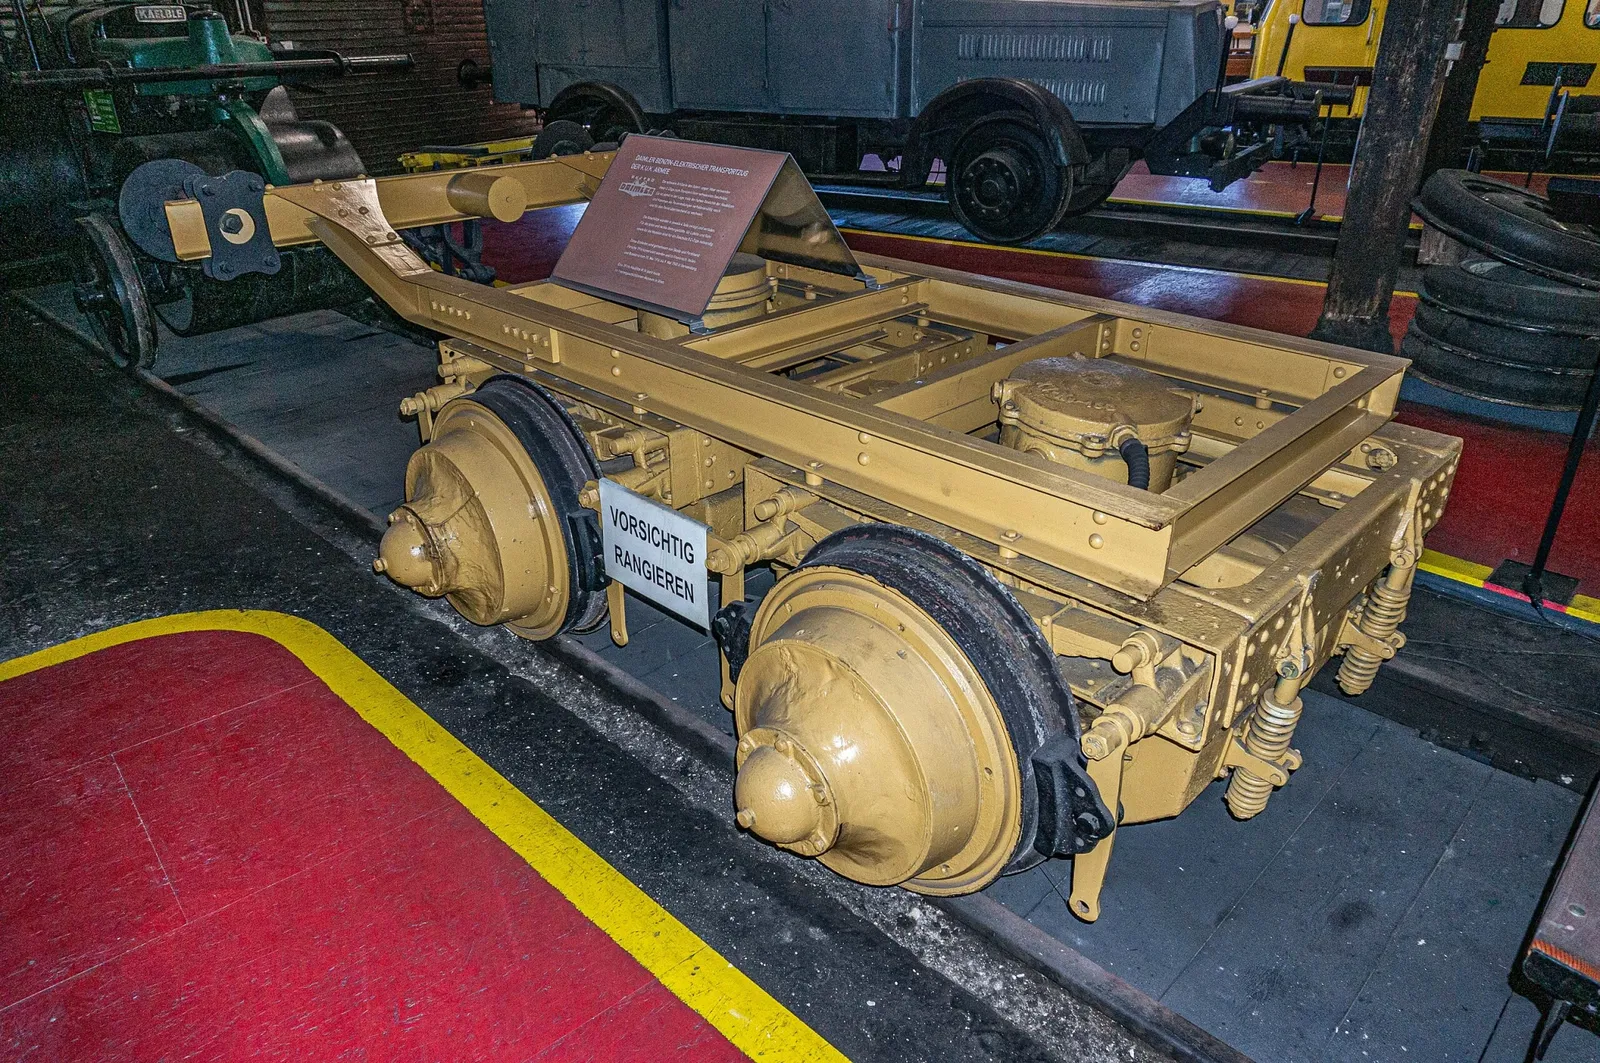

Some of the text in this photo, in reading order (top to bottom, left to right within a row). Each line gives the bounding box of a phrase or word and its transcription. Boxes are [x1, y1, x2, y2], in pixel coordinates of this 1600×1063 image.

[139, 9, 183, 19] KAELBLE
[635, 154, 656, 164] DAIMLER
[709, 164, 749, 177] TRANSPORTZUG
[653, 166, 671, 175] ARMEE
[609, 505, 695, 564] VORSICHTIG
[614, 544, 695, 603] RANGIEREN
